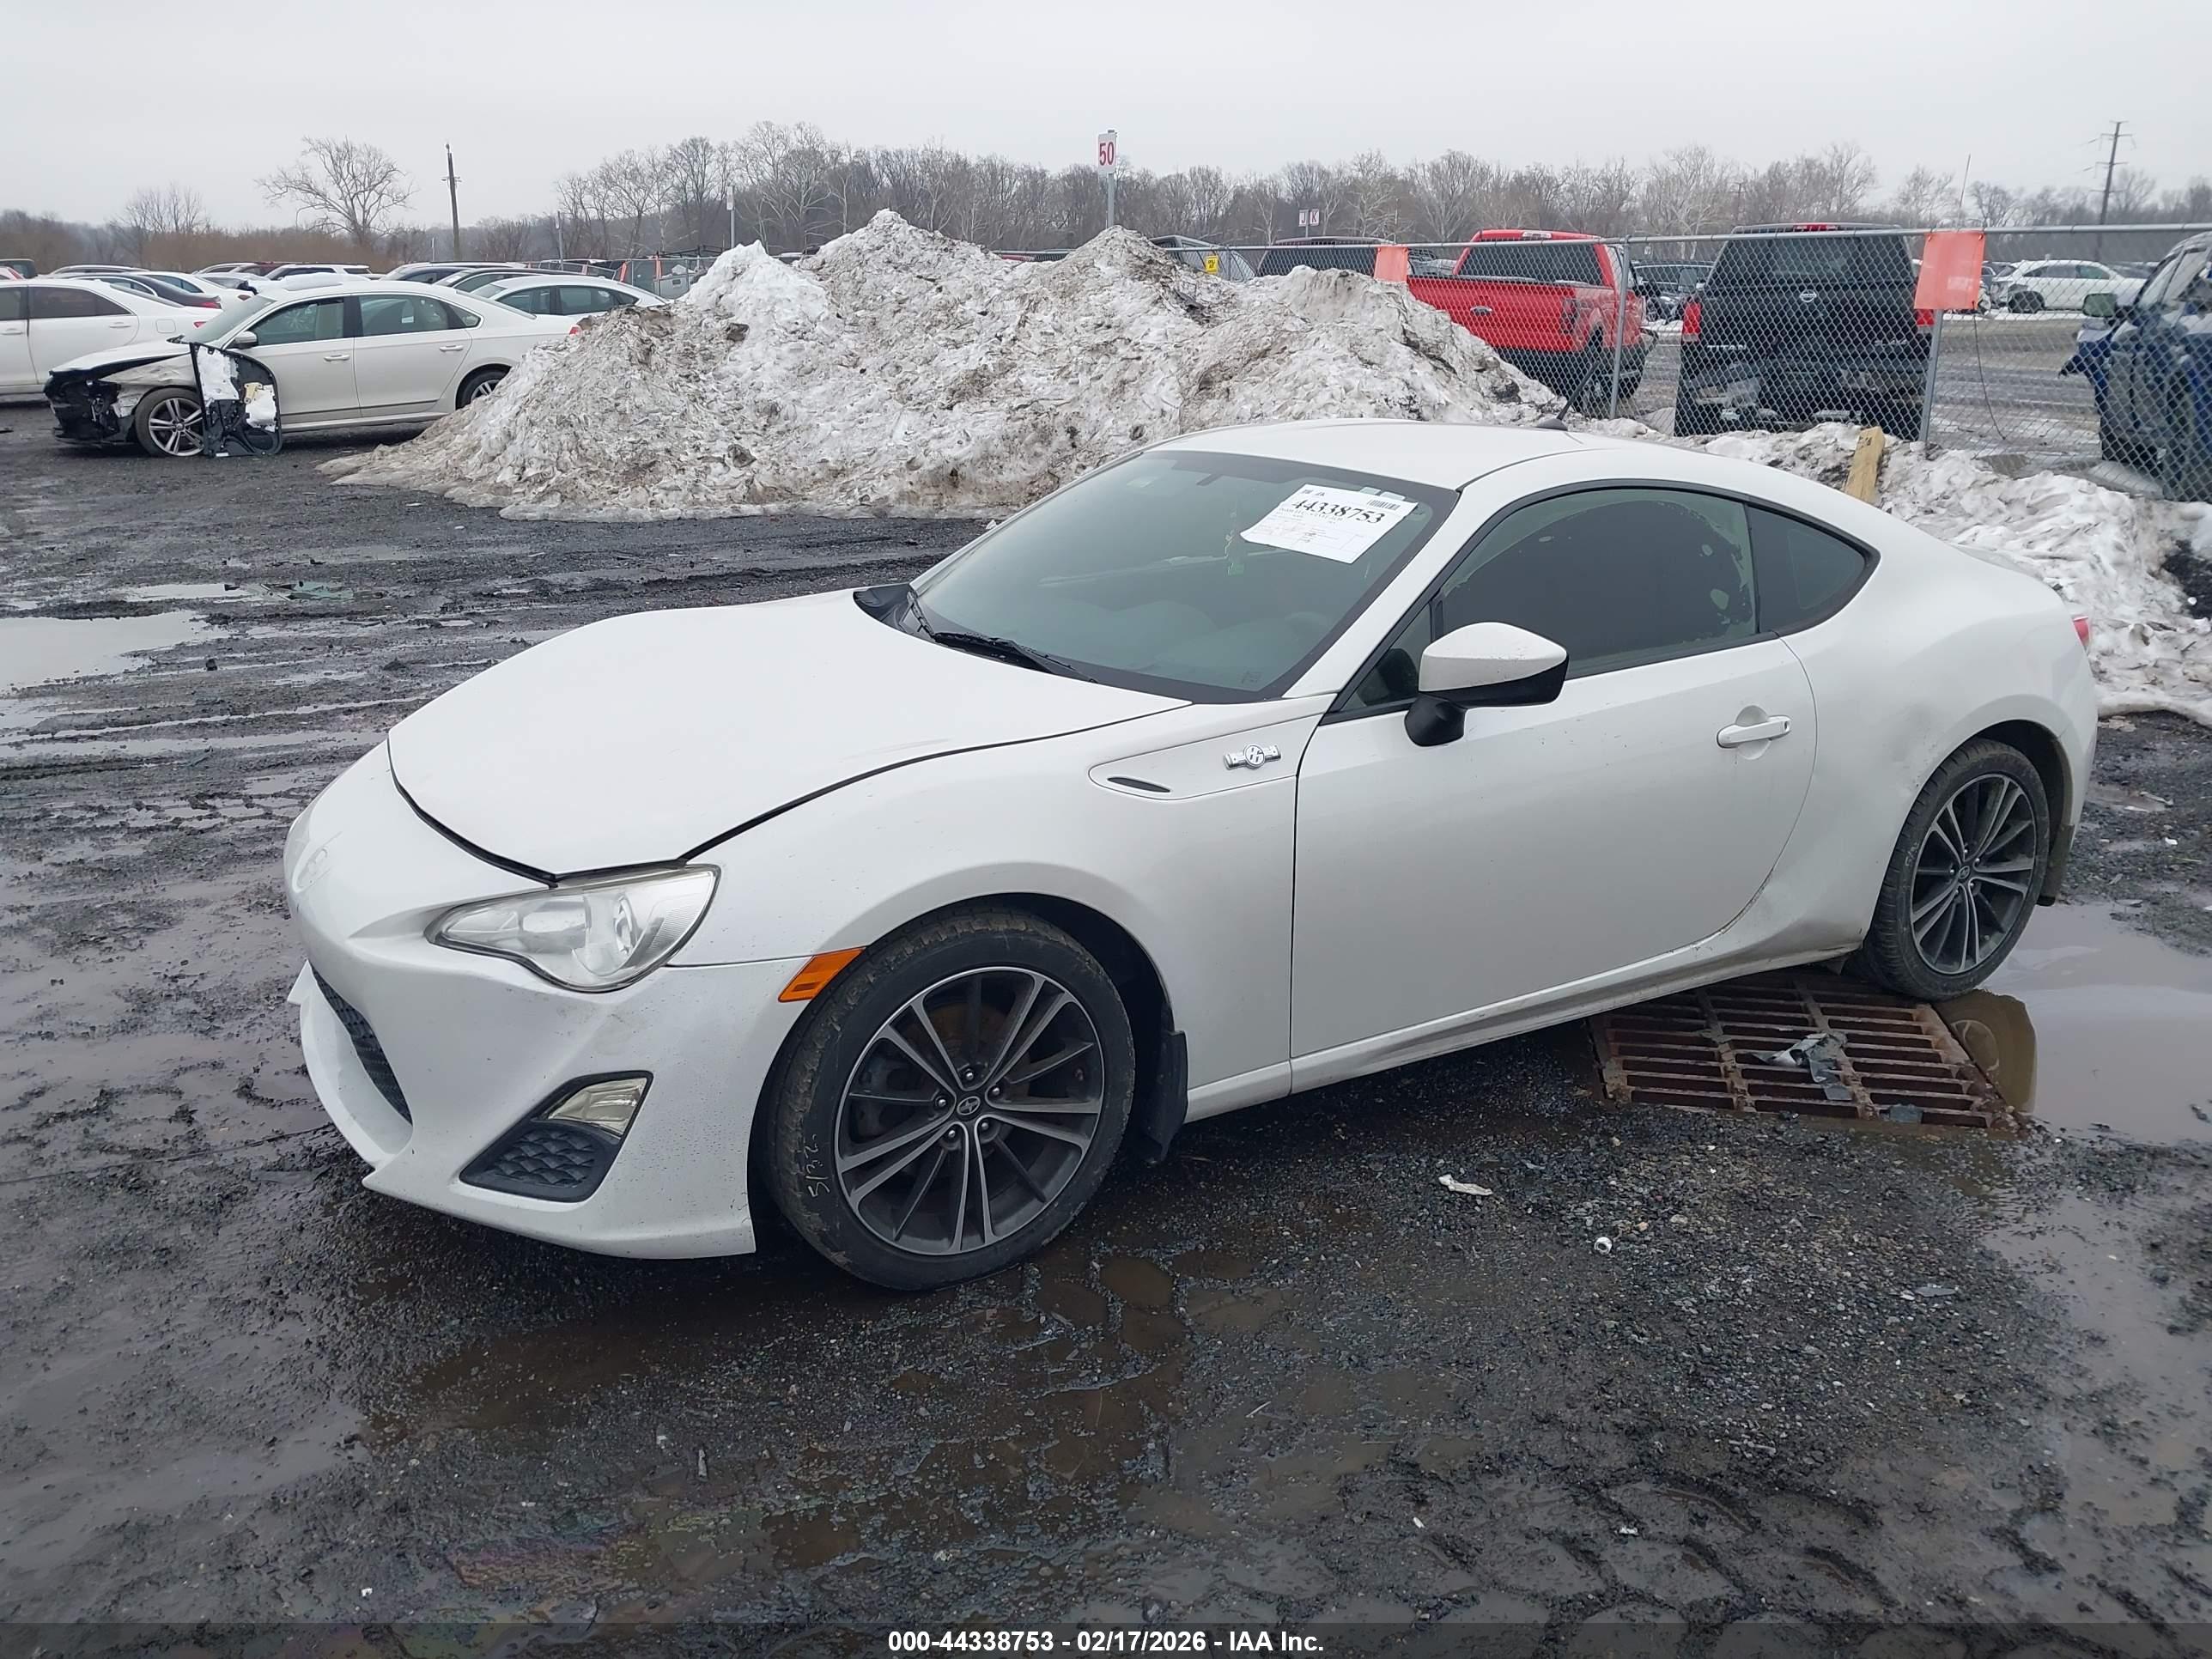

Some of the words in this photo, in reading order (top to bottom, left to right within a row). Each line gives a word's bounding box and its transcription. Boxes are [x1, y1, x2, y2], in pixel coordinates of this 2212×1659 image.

[1099, 142, 1115, 166] 50
[1311, 210, 1319, 222] K
[1291, 499, 1386, 524] 44338753
